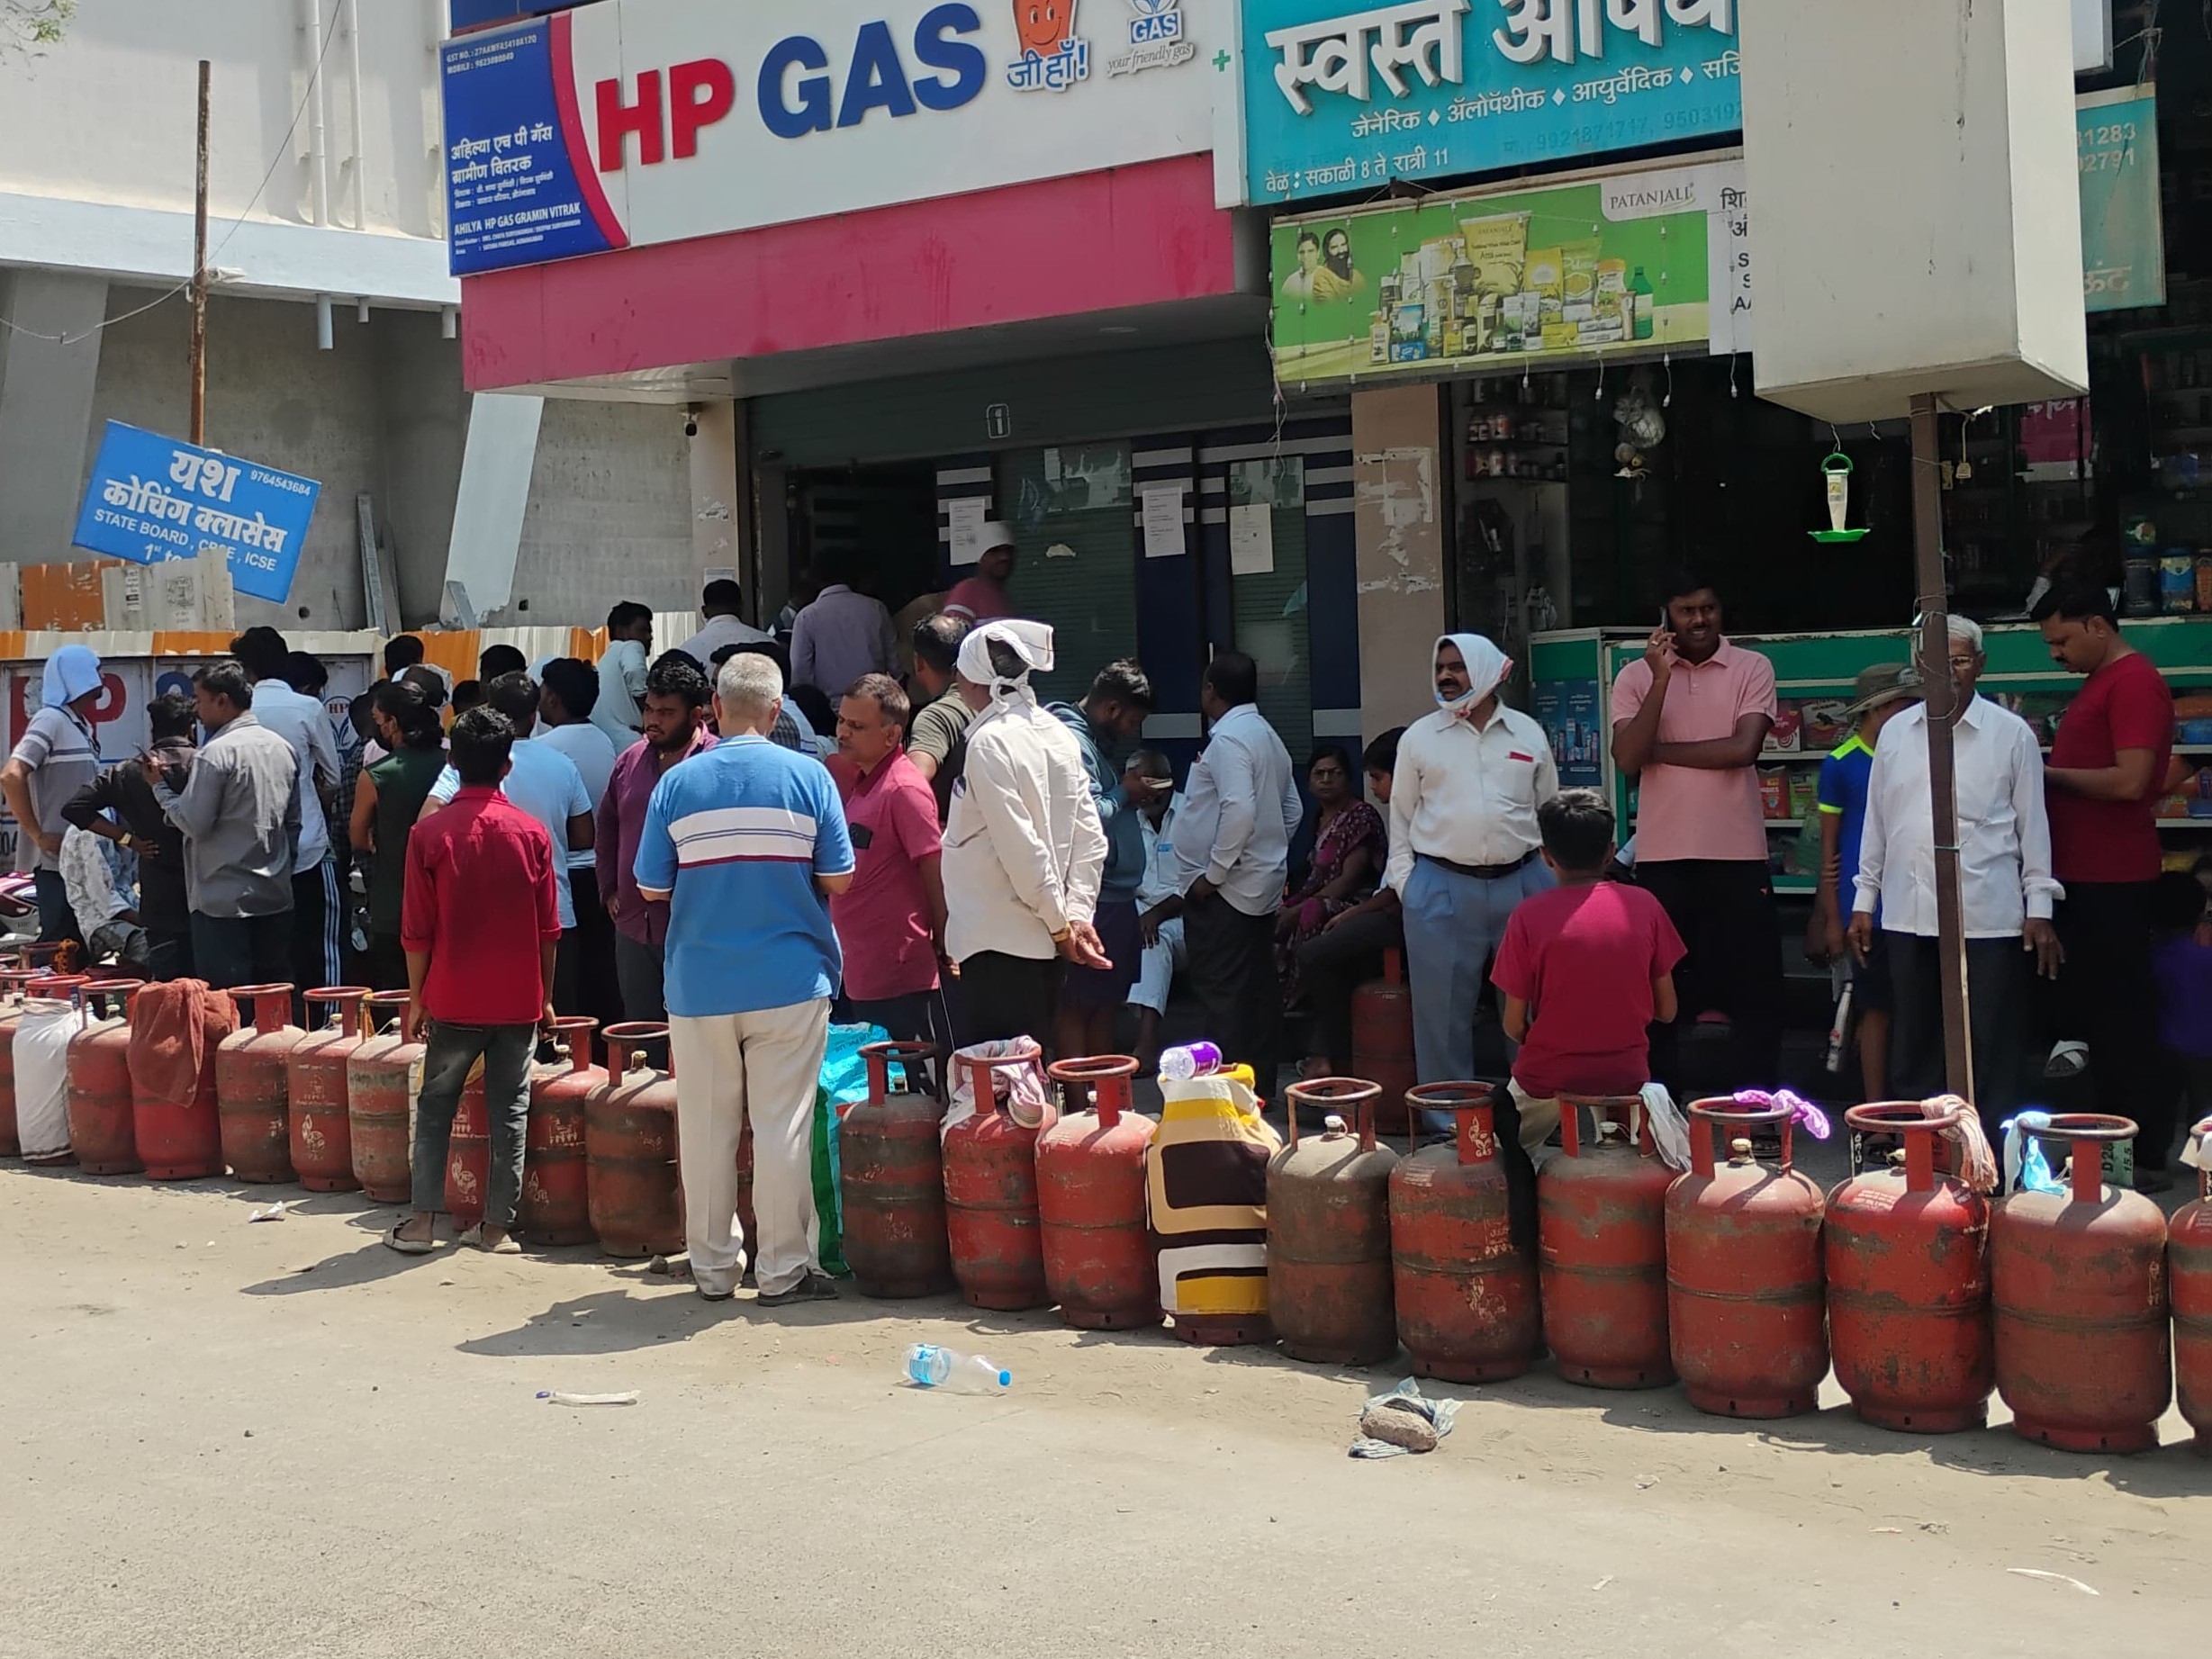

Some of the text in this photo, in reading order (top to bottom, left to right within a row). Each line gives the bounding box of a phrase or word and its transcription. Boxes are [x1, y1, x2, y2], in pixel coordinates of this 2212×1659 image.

[1132, 14, 1178, 43] GAS
[1106, 44, 1191, 75] your friendly gas
[595, 2, 986, 173] HP GAS
[1350, 108, 1422, 138] जेनेरिक
[1572, 66, 1674, 105] आयुर्वेदिक
[493, 134, 511, 154] एच
[514, 126, 528, 147] पी
[491, 155, 533, 177] वितरक
[1266, 169, 1289, 193] वेळ
[1305, 158, 1356, 187] सकाळी
[1360, 160, 1370, 179] 8
[1374, 152, 1386, 177] ते
[1393, 145, 1427, 173] रात्री
[1433, 148, 1448, 166] 11
[1610, 185, 1692, 210] PATANJALI
[454, 220, 483, 236] AHILYA
[484, 217, 496, 230] HP
[497, 213, 514, 228] GAS
[514, 208, 549, 225] GRAMIN
[549, 202, 582, 219] VITRAK
[168, 449, 242, 503] यश
[250, 468, 311, 496] 9764543684
[103, 474, 288, 554] कोचिंग क्लासेस
[95, 508, 139, 531] STATE
[245, 554, 277, 572] ICSE
[1475, 1147, 1493, 1159] GAS
